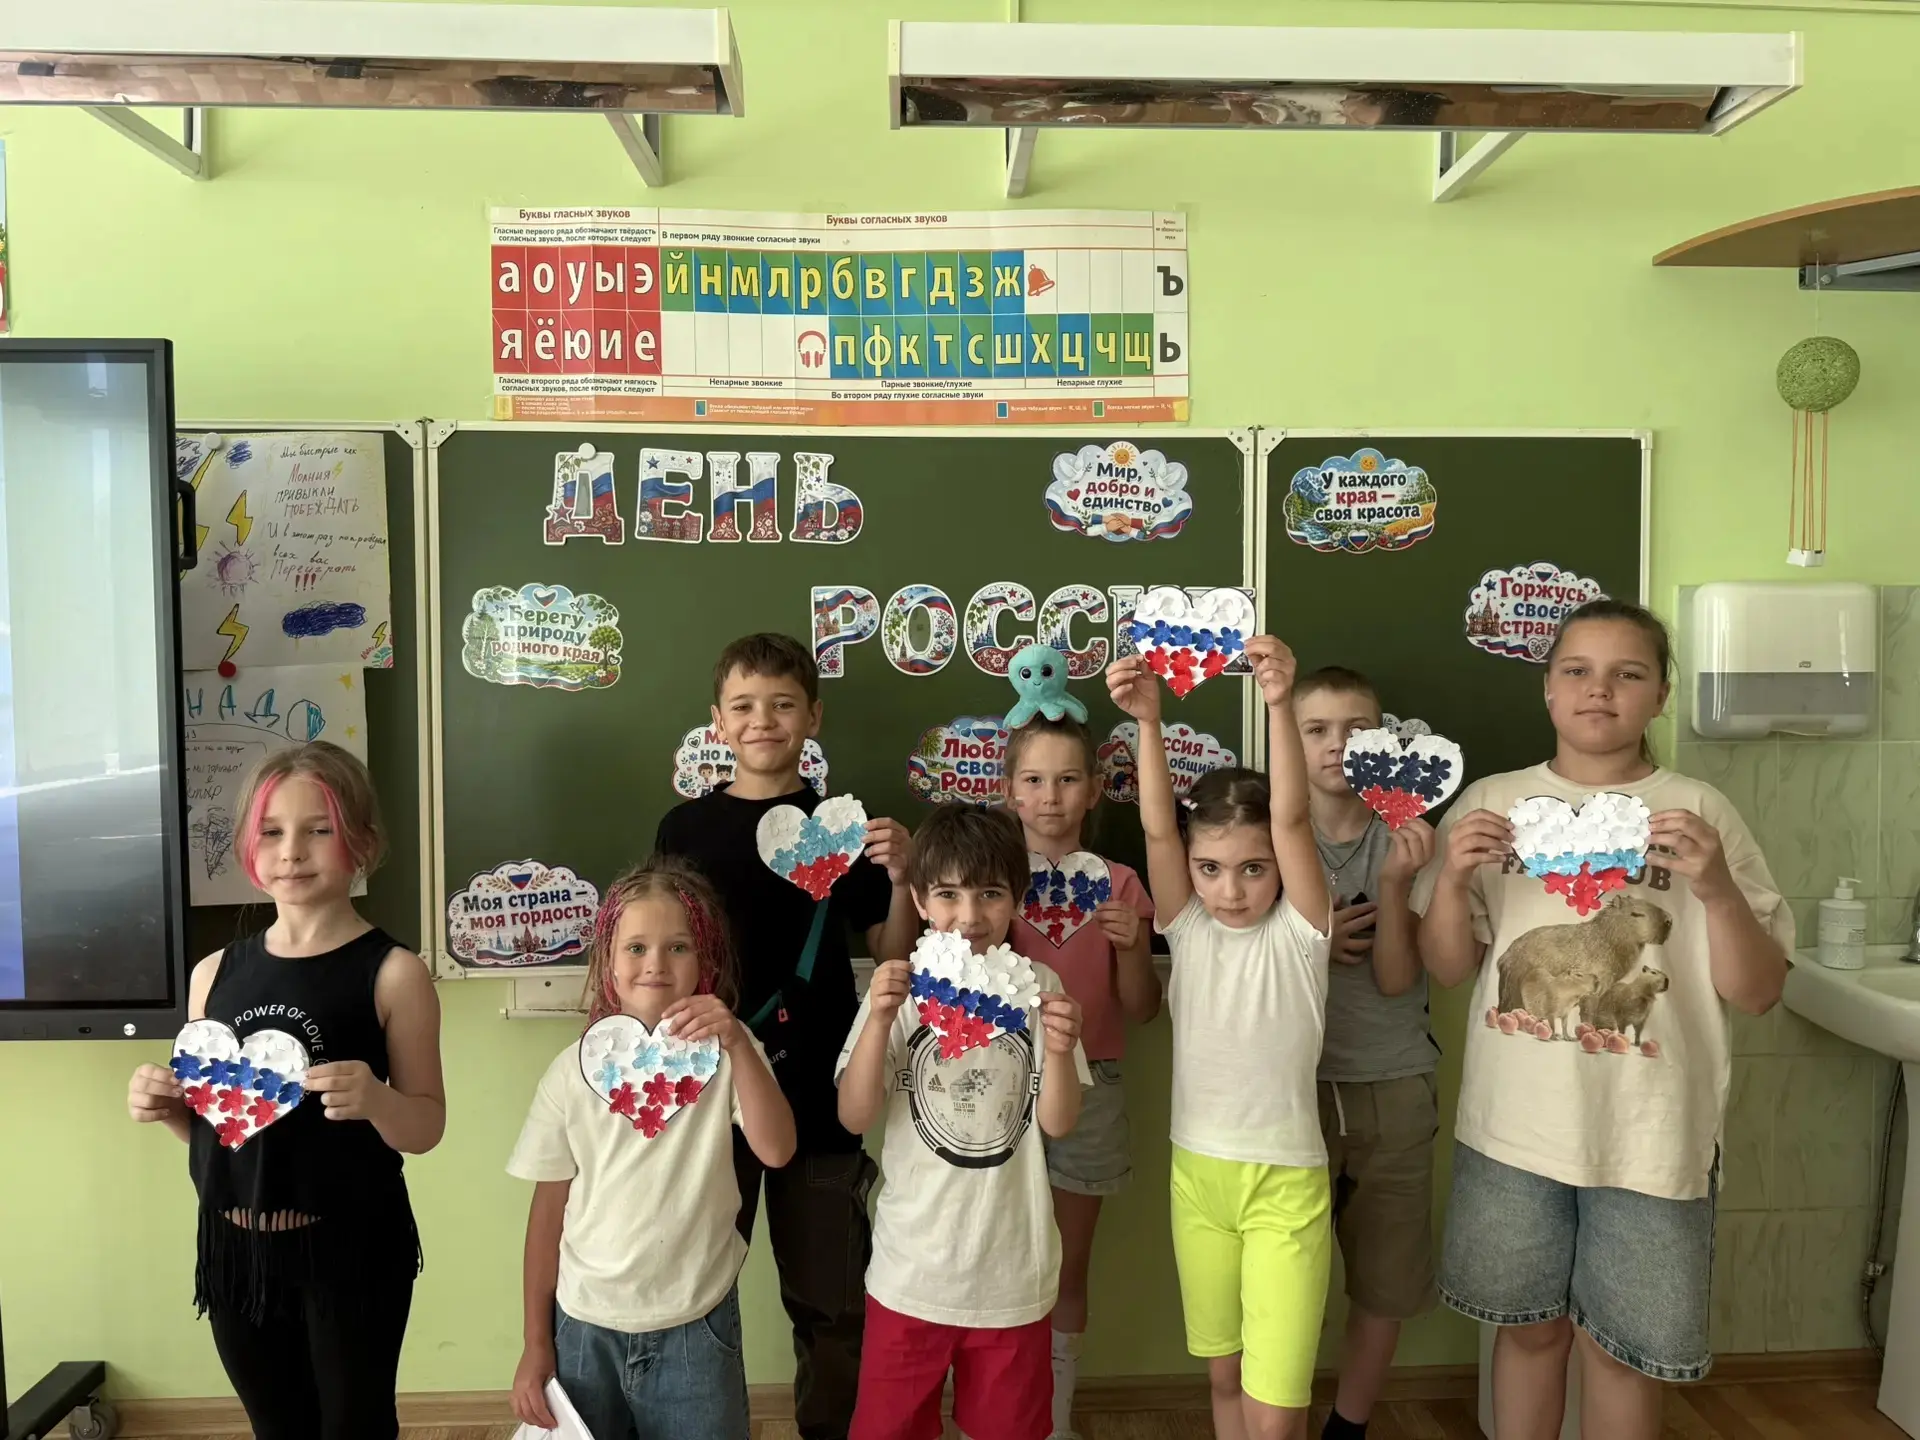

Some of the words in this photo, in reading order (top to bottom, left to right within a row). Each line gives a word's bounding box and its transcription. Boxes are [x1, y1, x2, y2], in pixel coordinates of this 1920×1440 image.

[519, 209, 551, 221] Буквы
[553, 209, 593, 218] гласных
[596, 209, 630, 219] звуков
[826, 214, 857, 226] Буквы
[860, 215, 912, 225] согласных
[914, 214, 948, 224] звуков
[493, 227, 524, 235] Гласные
[525, 228, 555, 236] первого
[556, 228, 573, 236] ряда
[575, 226, 618, 235] обозначают
[619, 227, 656, 236] твёрдость
[588, 235, 618, 243] которых
[620, 235, 652, 243] следуют
[662, 231, 668, 239] В
[669, 232, 699, 242] первом
[701, 233, 720, 242] ряду
[756, 236, 797, 244] согласные
[798, 237, 821, 245] звуки
[498, 261, 520, 294] а
[532, 261, 554, 294] о
[565, 261, 587, 304] у
[595, 261, 624, 294] ы
[633, 262, 653, 294] э
[667, 251, 689, 295] й
[700, 264, 722, 296] н
[730, 266, 759, 297] м
[768, 266, 789, 298] л
[800, 266, 822, 310] р
[831, 256, 854, 300] б
[864, 267, 887, 299] в
[900, 267, 917, 298] г
[929, 267, 955, 306] д
[965, 266, 984, 298] з
[994, 265, 1021, 297] ж
[500, 328, 523, 360] я
[534, 318, 556, 361] ё
[563, 329, 591, 360] ю
[600, 329, 621, 360] и
[634, 330, 656, 362] е
[834, 335, 856, 366] п
[863, 324, 892, 377] ф
[900, 334, 921, 365] к
[933, 334, 953, 365] т
[967, 334, 984, 365] с
[994, 333, 1022, 365] ш
[1030, 333, 1051, 364] х
[1061, 333, 1085, 371] ц
[1095, 332, 1117, 363] ч
[1124, 332, 1151, 370] щ
[499, 376, 529, 384] Гласные
[531, 378, 560, 386] второго
[561, 378, 579, 386] ряда
[580, 377, 622, 385] обозначают
[541, 385, 567, 393] звуков,
[709, 378, 749, 388] Непарные
[881, 380, 911, 389] Парные
[913, 379, 973, 389] звонкие/глухие
[1057, 379, 1095, 387] Непарные
[1097, 379, 1123, 387] глухие
[831, 391, 842, 399] Во
[843, 392, 872, 400] втором
[873, 392, 892, 400] ряду
[893, 392, 920, 400] глухие
[921, 391, 961, 399] согласные
[962, 391, 984, 399] звуки
[1096, 462, 1142, 482] Мир,
[1321, 471, 1333, 489] У
[1338, 473, 1407, 489] каждого
[543, 448, 864, 545] ДЕНЬ
[1085, 479, 1140, 497] добро
[1144, 487, 1155, 498] и
[1082, 496, 1162, 514] единство
[1335, 490, 1377, 508] края
[1315, 507, 1352, 521] своя
[1357, 505, 1420, 522] красота
[1500, 577, 1587, 604] Горжусь
[508, 605, 585, 629] Берегу
[504, 624, 587, 646] природу
[811, 581, 1256, 678] РОСС
[1500, 620, 1559, 638] стран
[491, 641, 559, 657] родного
[562, 647, 600, 662] края
[941, 738, 1006, 759] Любл
[462, 895, 503, 913] Моя
[508, 888, 572, 910] страна
[470, 916, 506, 931] моя
[510, 904, 592, 927] гордость
[234, 1004, 286, 1027] POWER
[287, 1007, 307, 1021] OF
[302, 1018, 324, 1053] LOVE
